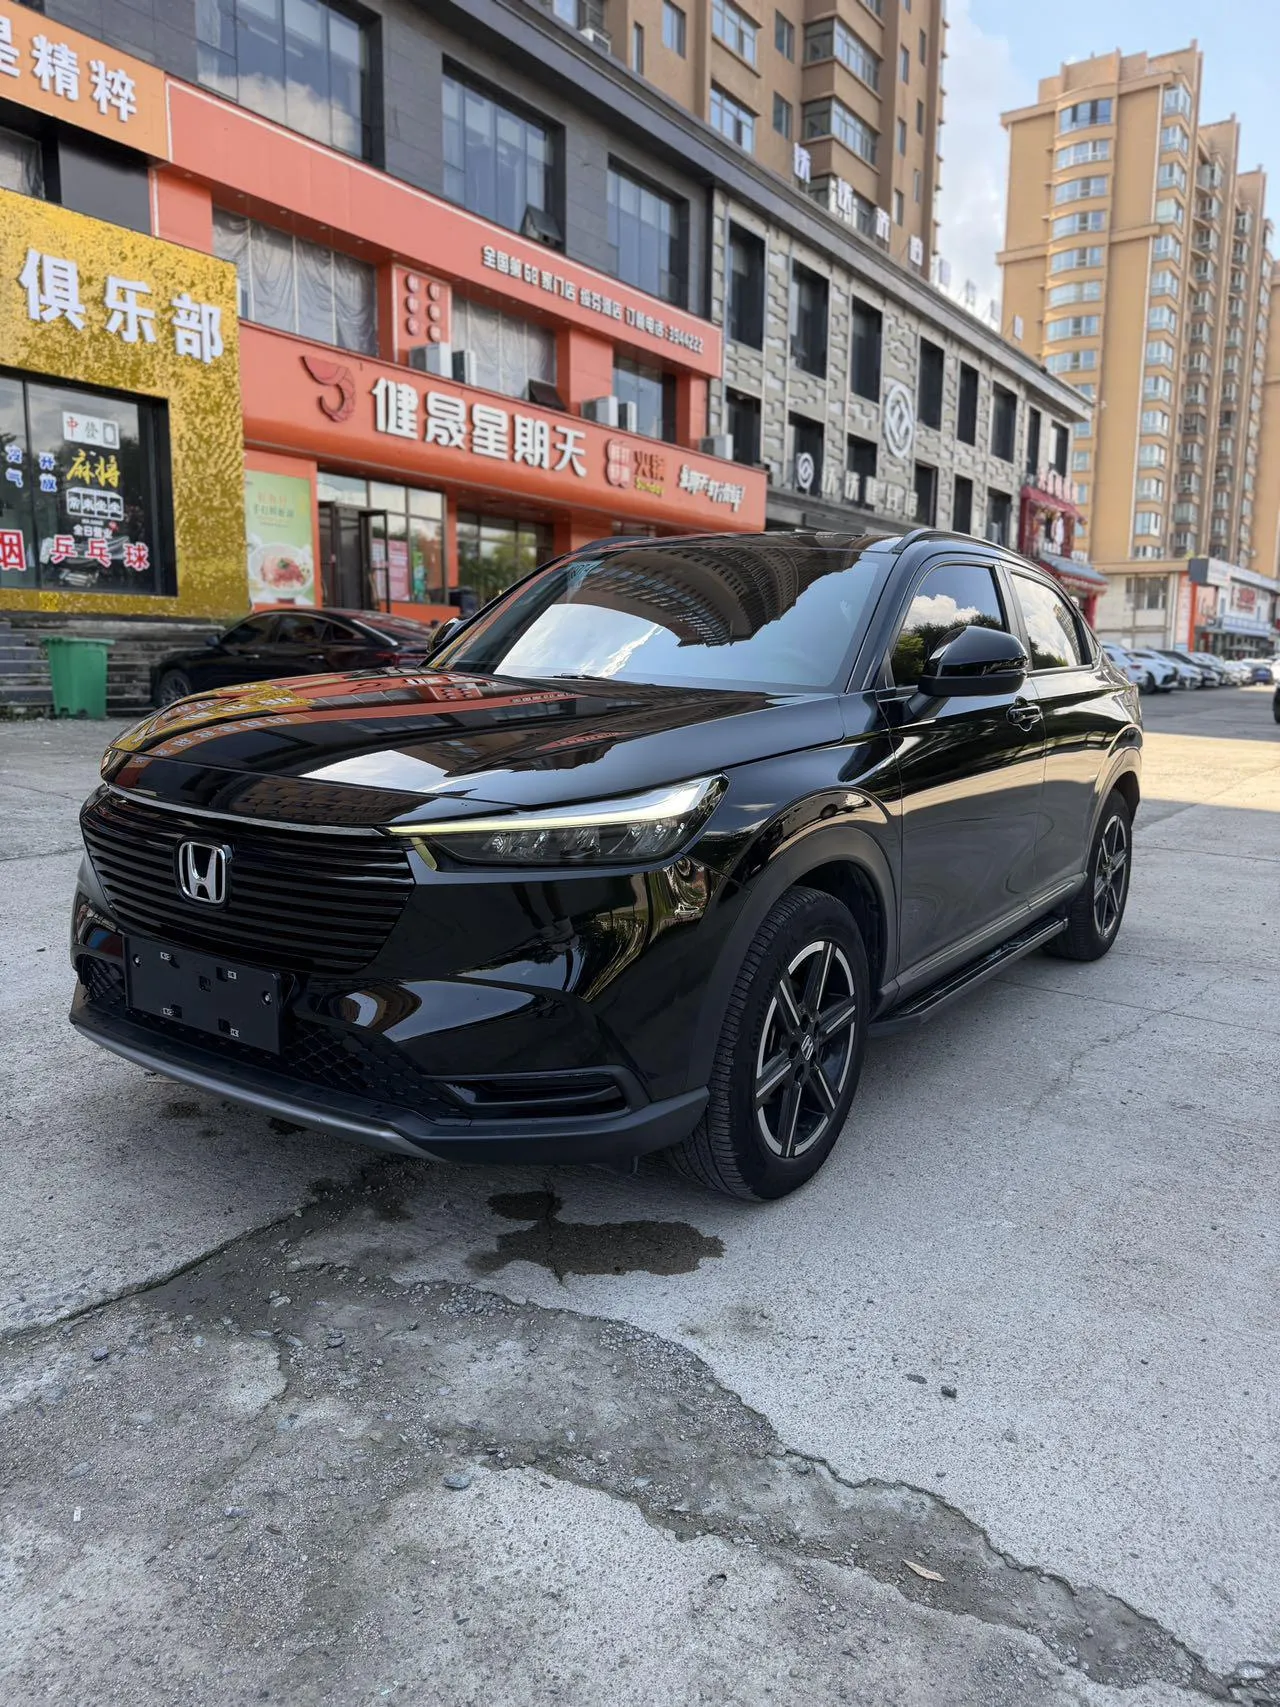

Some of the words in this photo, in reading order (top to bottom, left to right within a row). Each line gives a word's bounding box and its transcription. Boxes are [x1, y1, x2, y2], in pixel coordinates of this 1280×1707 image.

[18, 248, 225, 364] 俱乐部
[371, 376, 588, 478] 健晟星期天
[66, 448, 121, 488] 麻将
[51, 534, 150, 571] 乒乓球
